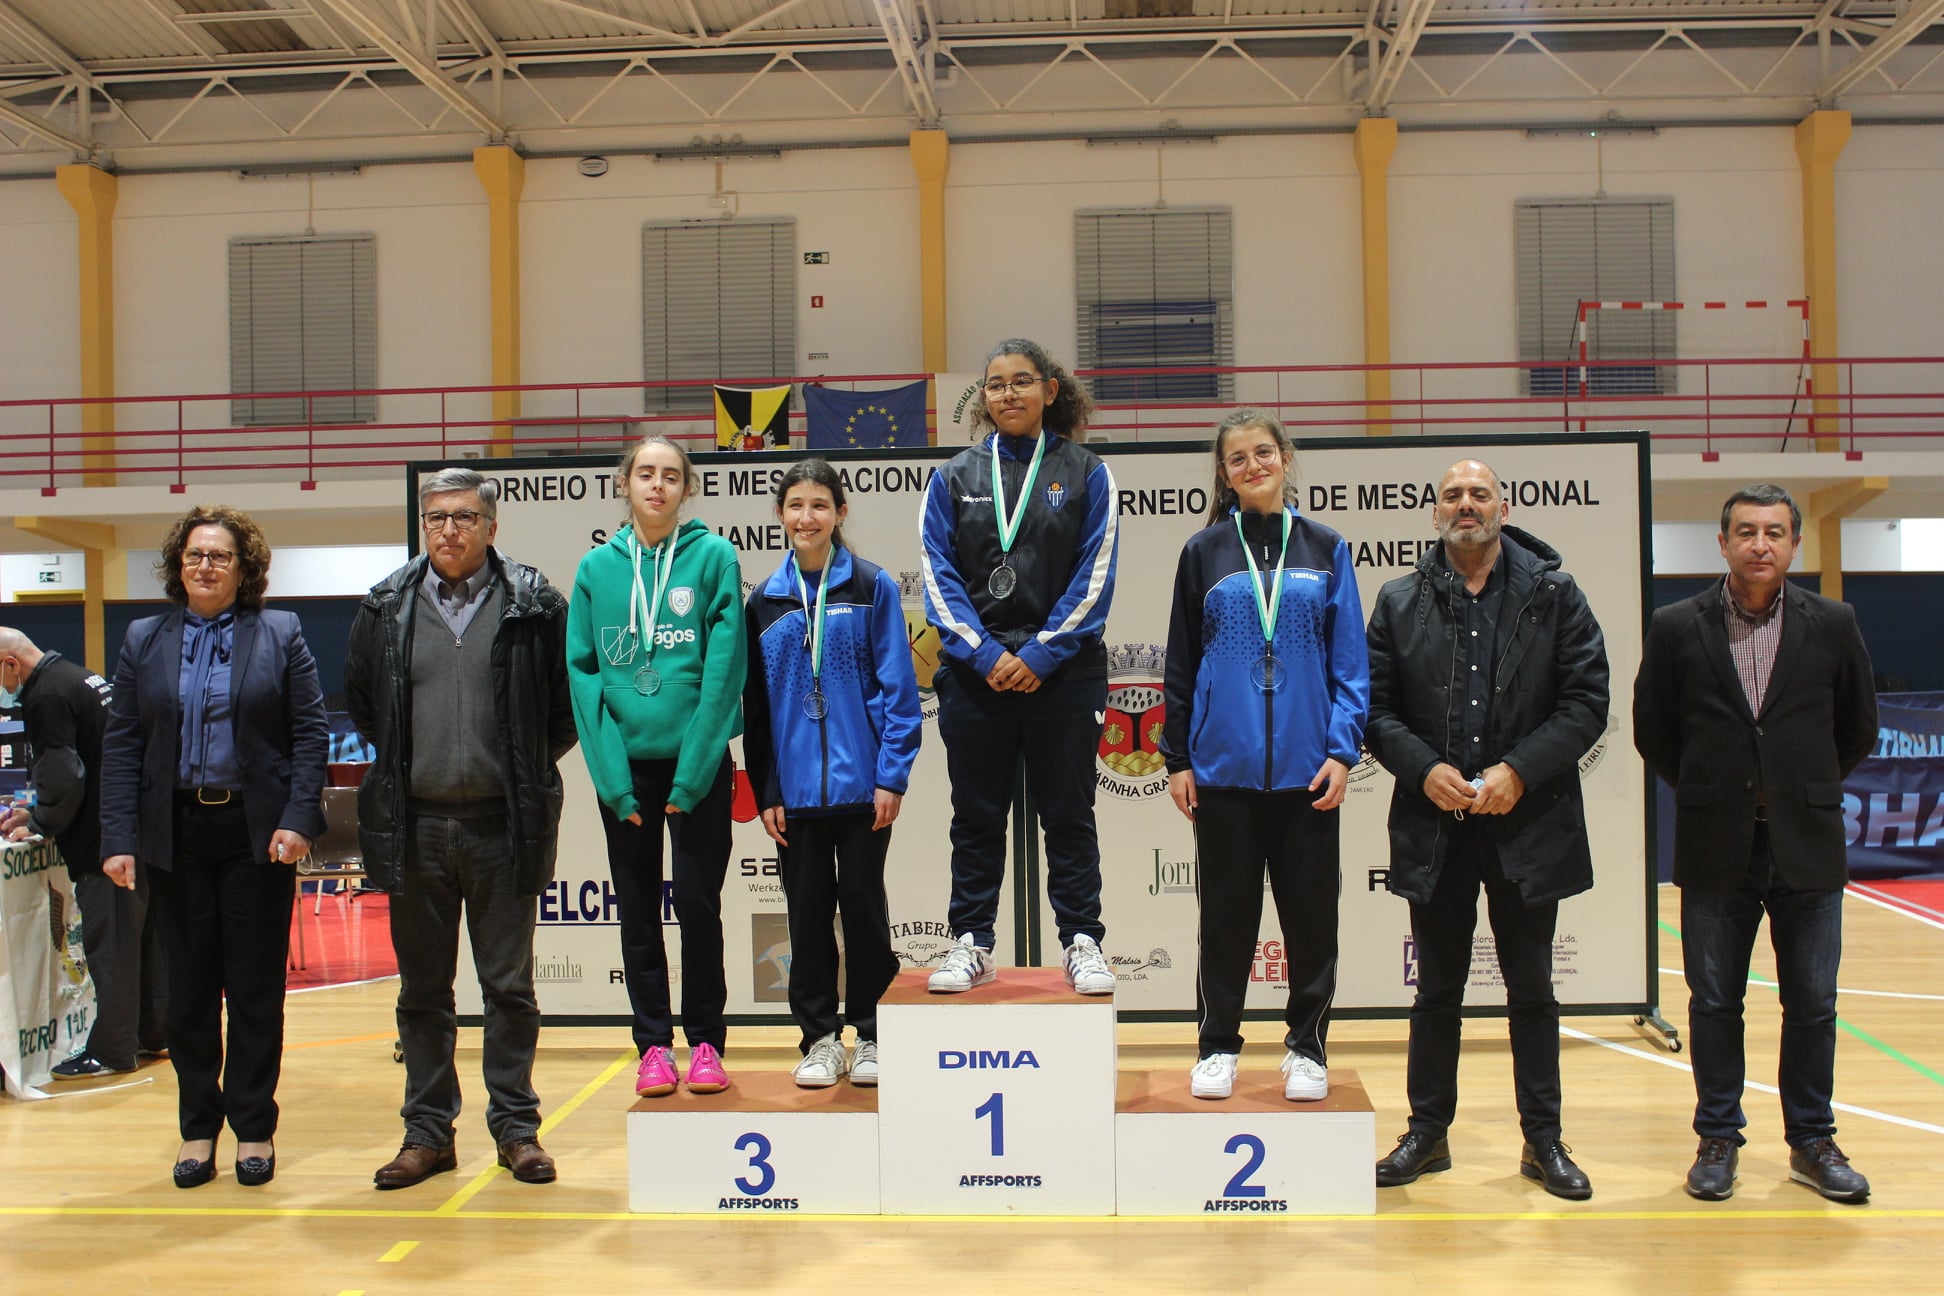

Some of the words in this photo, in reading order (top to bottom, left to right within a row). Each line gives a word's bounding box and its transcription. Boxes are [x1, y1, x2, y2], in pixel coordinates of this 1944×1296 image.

[729, 470, 785, 495] MES
[1310, 485, 1347, 511] DE
[1289, 572, 1319, 582] TIBHAR
[826, 607, 853, 616] TIBHAR
[653, 628, 696, 650] agos
[1878, 726, 1944, 759] TIBHA
[1578, 743, 1605, 773] LEIRIA
[1096, 769, 1141, 798] ARINHA
[890, 921, 958, 941] TABERN
[1560, 934, 1578, 943] Lda.
[907, 940, 938, 953] Grupo
[938, 1050, 1041, 1069] DIMA
[975, 1092, 1004, 1156] 1
[734, 1132, 776, 1196] 3
[1222, 1133, 1266, 1197] 2
[958, 1174, 1042, 1187] AFFSPORTS
[718, 1197, 800, 1210] AFFSPORTS
[1203, 1200, 1288, 1212] AFFSPORTS
